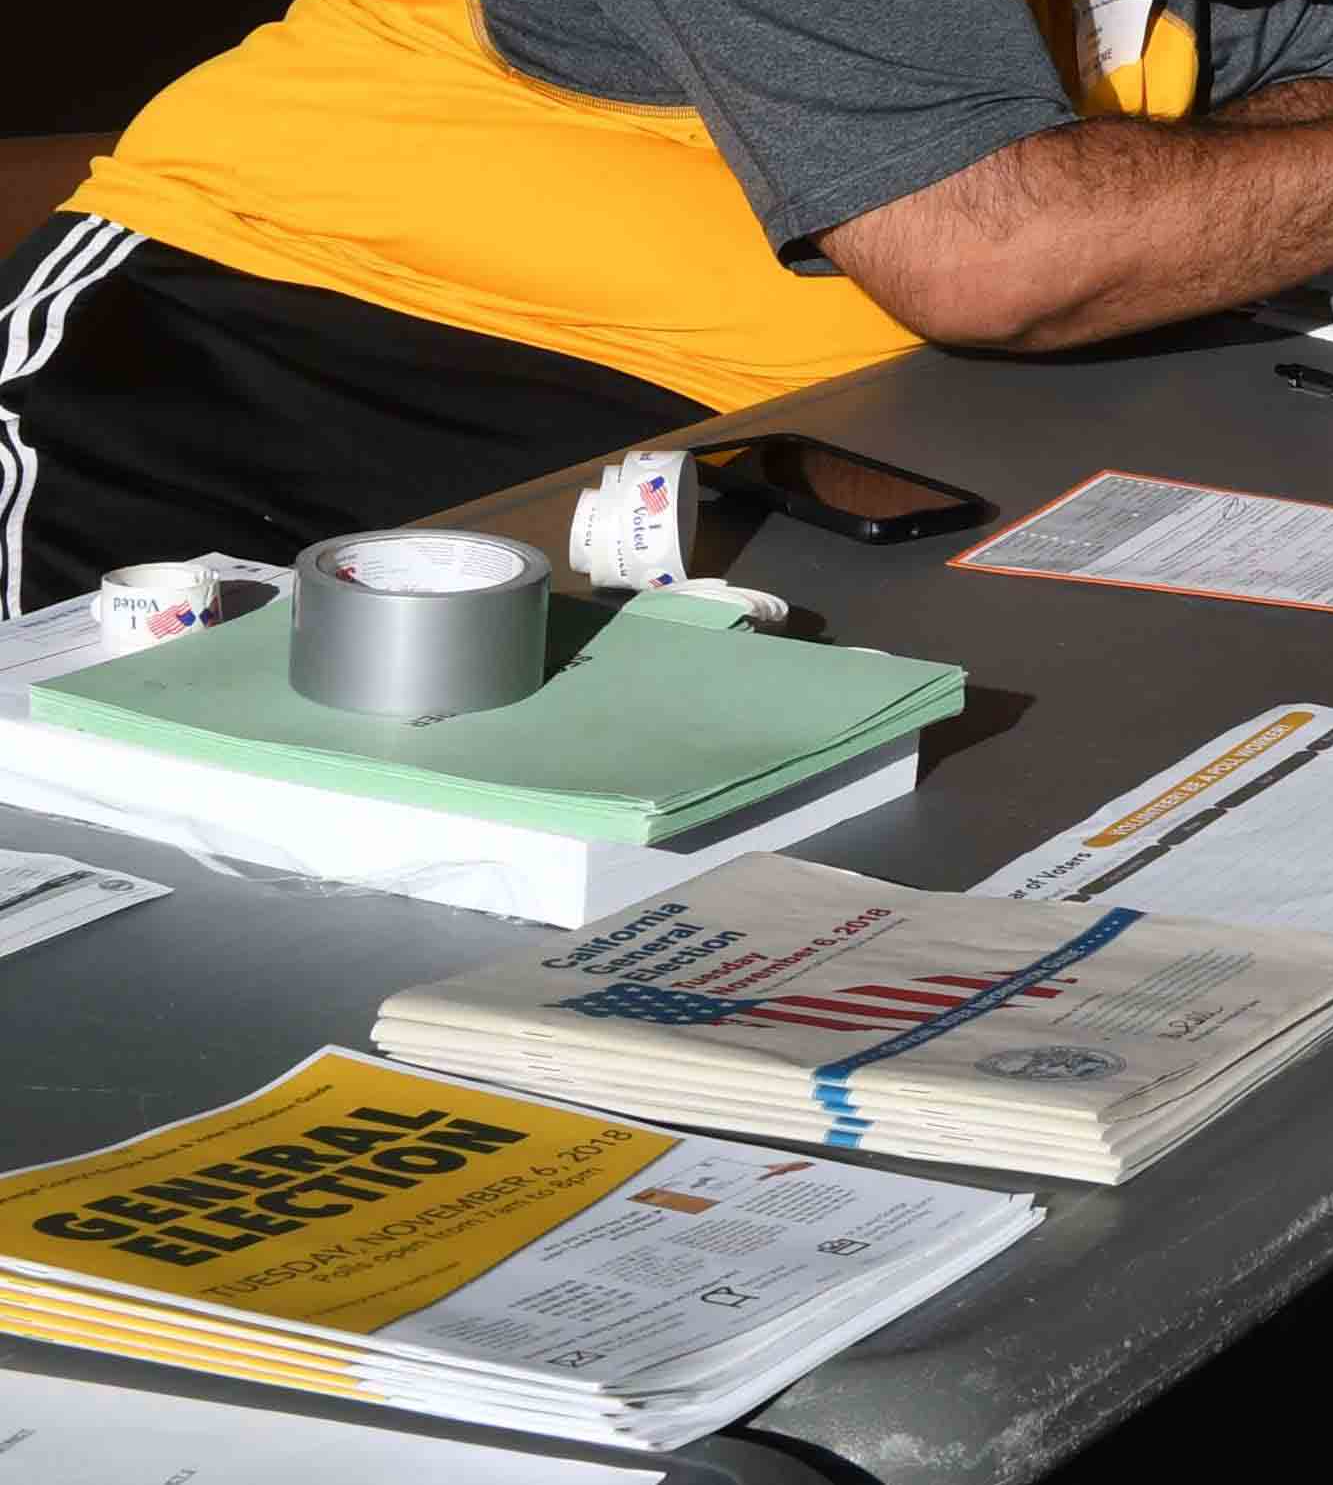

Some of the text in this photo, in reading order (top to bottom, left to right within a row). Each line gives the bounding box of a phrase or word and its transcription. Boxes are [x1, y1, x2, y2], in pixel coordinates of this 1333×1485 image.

[632, 506, 649, 551] Voted
[112, 596, 160, 613] Voted
[1035, 852, 1092, 878] Voters
[540, 900, 690, 972] California
[581, 922, 706, 976] General
[621, 928, 750, 985] Election
[706, 945, 815, 996] November
[833, 907, 895, 938] 2018
[670, 950, 769, 991] Tuesday
[32, 1106, 451, 1241] GENERAL
[110, 1118, 530, 1267] ELECTION
[358, 1172, 536, 1247] NOVEMBER
[557, 1128, 634, 1164] 2018
[311, 1256, 366, 1285] Polls
[372, 1240, 427, 1266] open
[429, 1212, 484, 1242] from
[553, 1167, 604, 1194] 8pm
